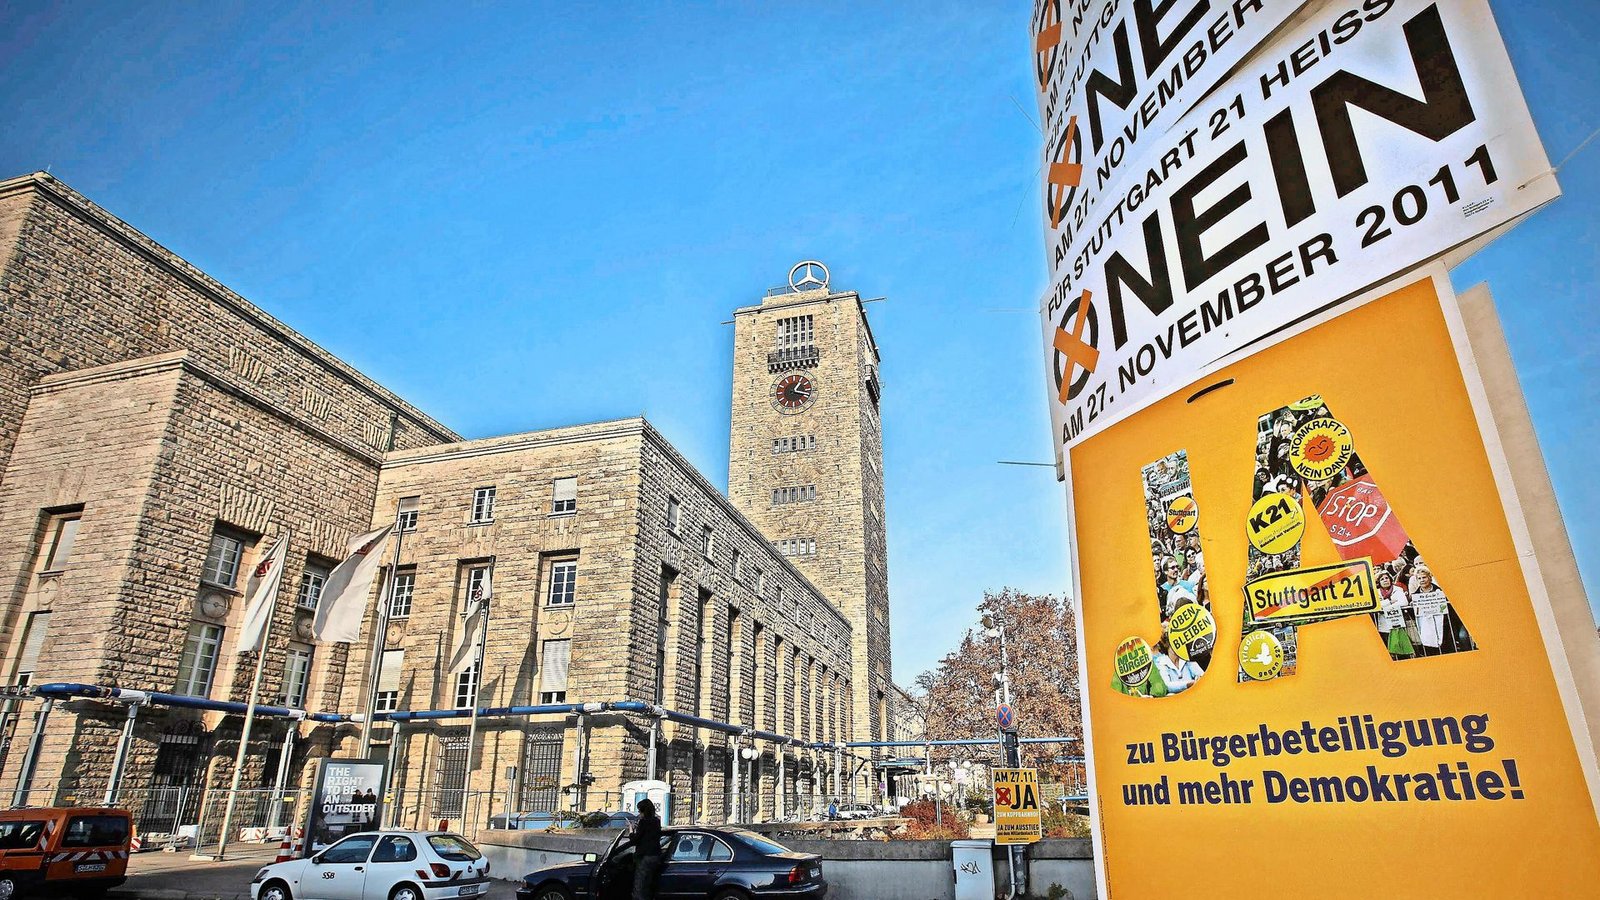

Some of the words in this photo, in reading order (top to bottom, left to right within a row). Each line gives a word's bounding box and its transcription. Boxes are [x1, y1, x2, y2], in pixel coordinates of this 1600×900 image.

[1046, 80, 1058, 129] AM
[1055, 222, 1073, 272] AM
[1075, 188, 1095, 232] 27.
[1097, 0, 1263, 191] NOVEMBER
[1104, 2, 1476, 351] NEIN
[1048, 274, 1071, 321] FÜR
[1074, 128, 1198, 281] STUTTGART
[1209, 94, 1246, 141] 21
[1063, 406, 1084, 444] AM
[1087, 381, 1114, 423] 27.
[1117, 232, 1339, 394] NOVEMBER
[1355, 143, 1498, 249] 2011
[1296, 462, 1322, 478] NEIN
[1324, 444, 1351, 476] DANKE
[1168, 508, 1196, 518] Stuttgart
[1249, 498, 1291, 534] K21
[1254, 579, 1338, 609] Stuttgart
[1340, 575, 1364, 599] 21
[1171, 606, 1196, 629] OBEN
[1173, 615, 1212, 650] BLEIBEN
[1117, 645, 1146, 666] MUT
[1125, 741, 1155, 765] zu
[1161, 713, 1496, 767] Bürgerbeteiligung
[327, 777, 364, 786] RIGHT
[329, 767, 351, 776] THE
[995, 772, 1008, 782] AM
[1010, 772, 1036, 782] 27.11.
[1122, 775, 1169, 806] und
[1178, 773, 1254, 805] mehr
[1262, 759, 1526, 804] Demokratie!
[323, 795, 341, 804] AN
[326, 786, 340, 795] TO
[342, 786, 357, 795] BE
[1010, 785, 1037, 809] JA
[322, 803, 375, 814] OUTSIDER
[1016, 823, 1040, 831] AUSSTIEG
[321, 871, 336, 880] SSB
